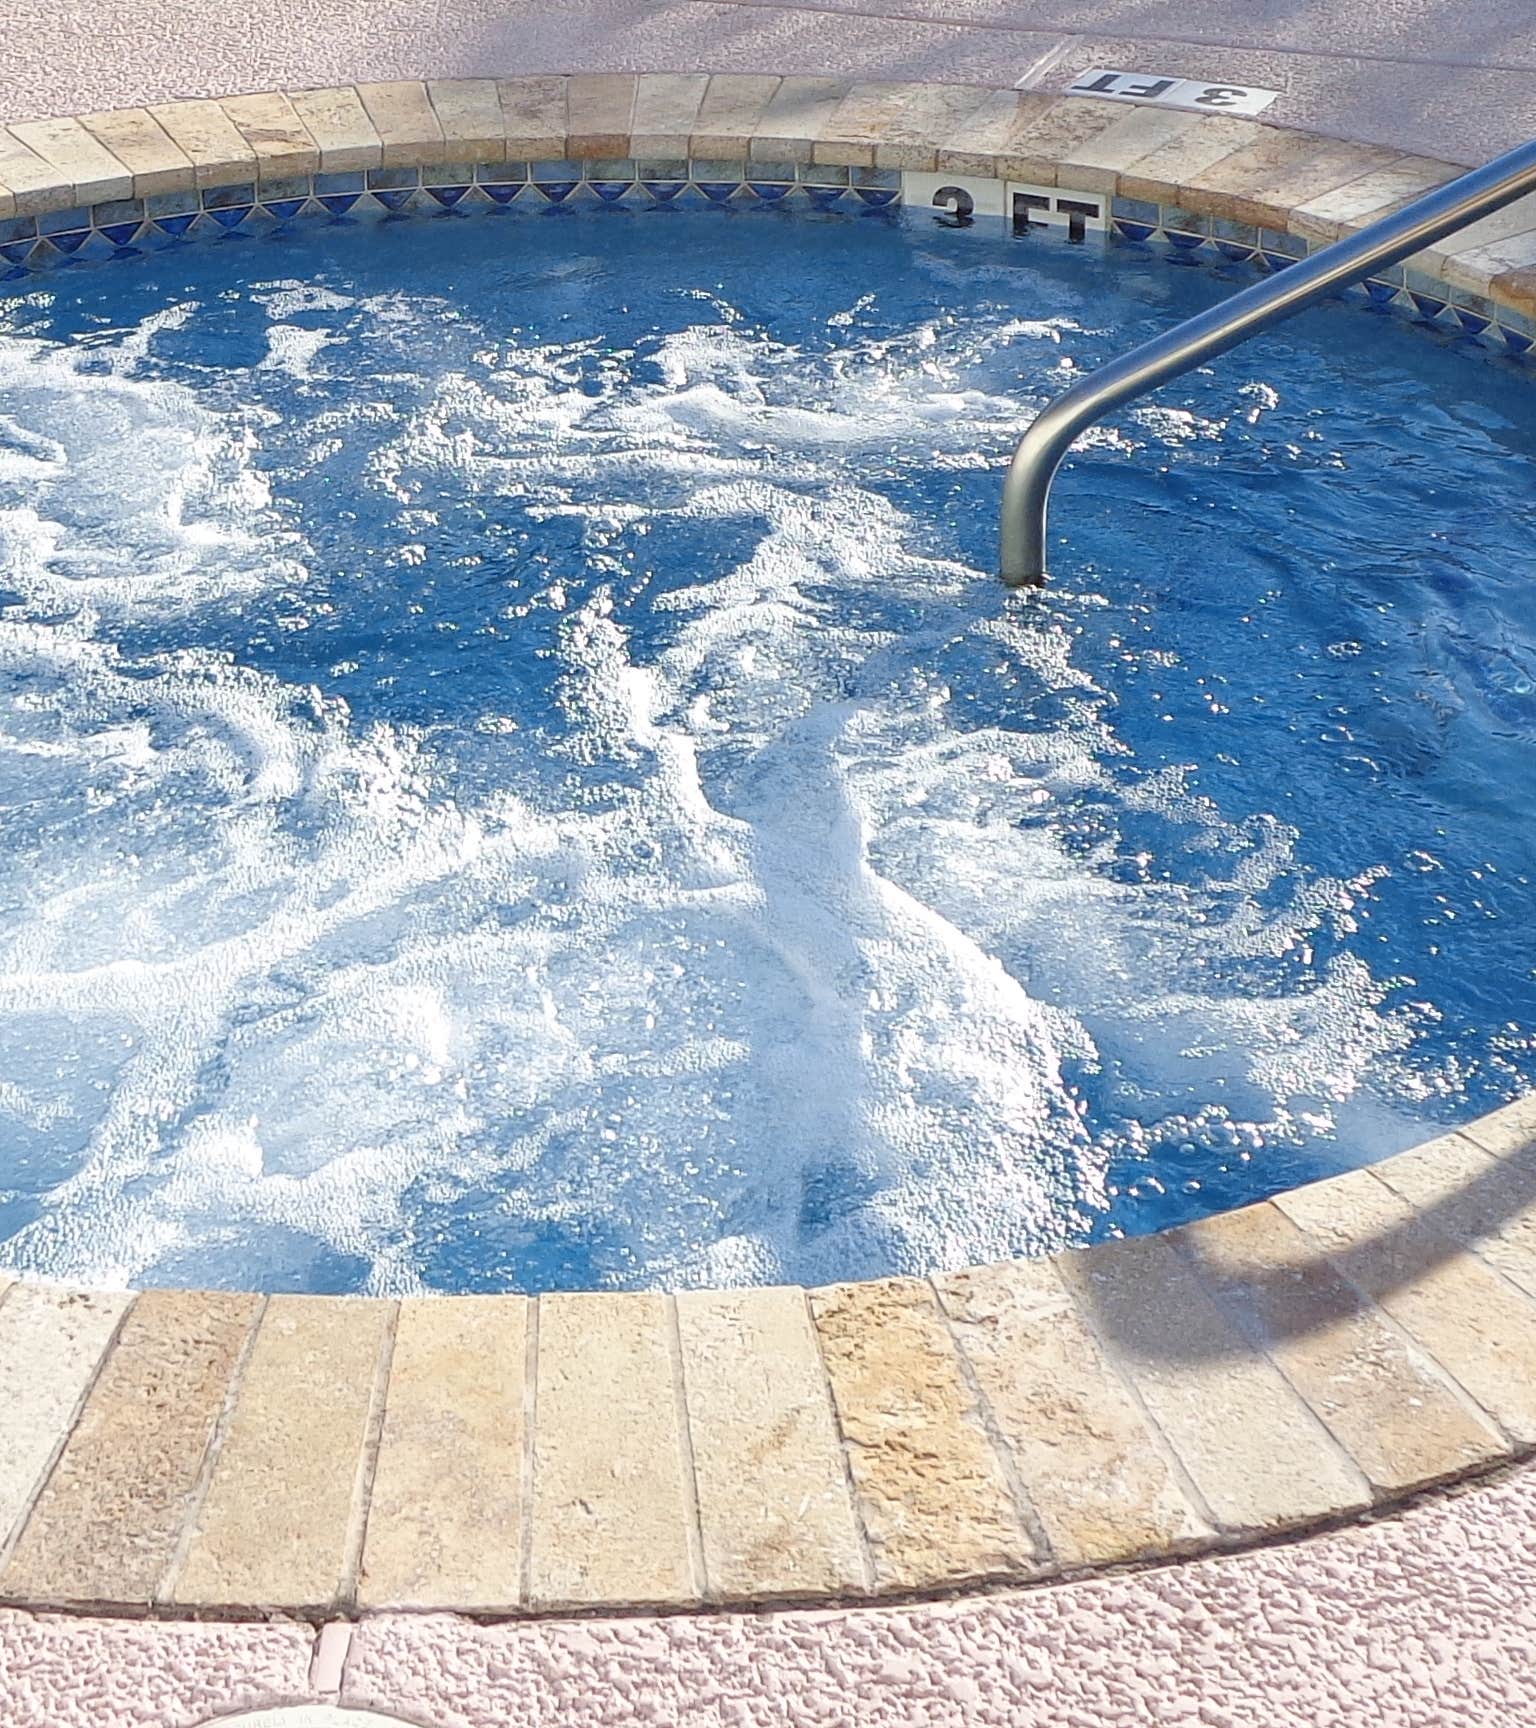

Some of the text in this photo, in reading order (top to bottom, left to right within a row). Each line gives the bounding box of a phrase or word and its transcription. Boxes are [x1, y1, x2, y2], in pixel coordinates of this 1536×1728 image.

[1070, 73, 1248, 107] 3 FT
[1012, 191, 1100, 244] FT
